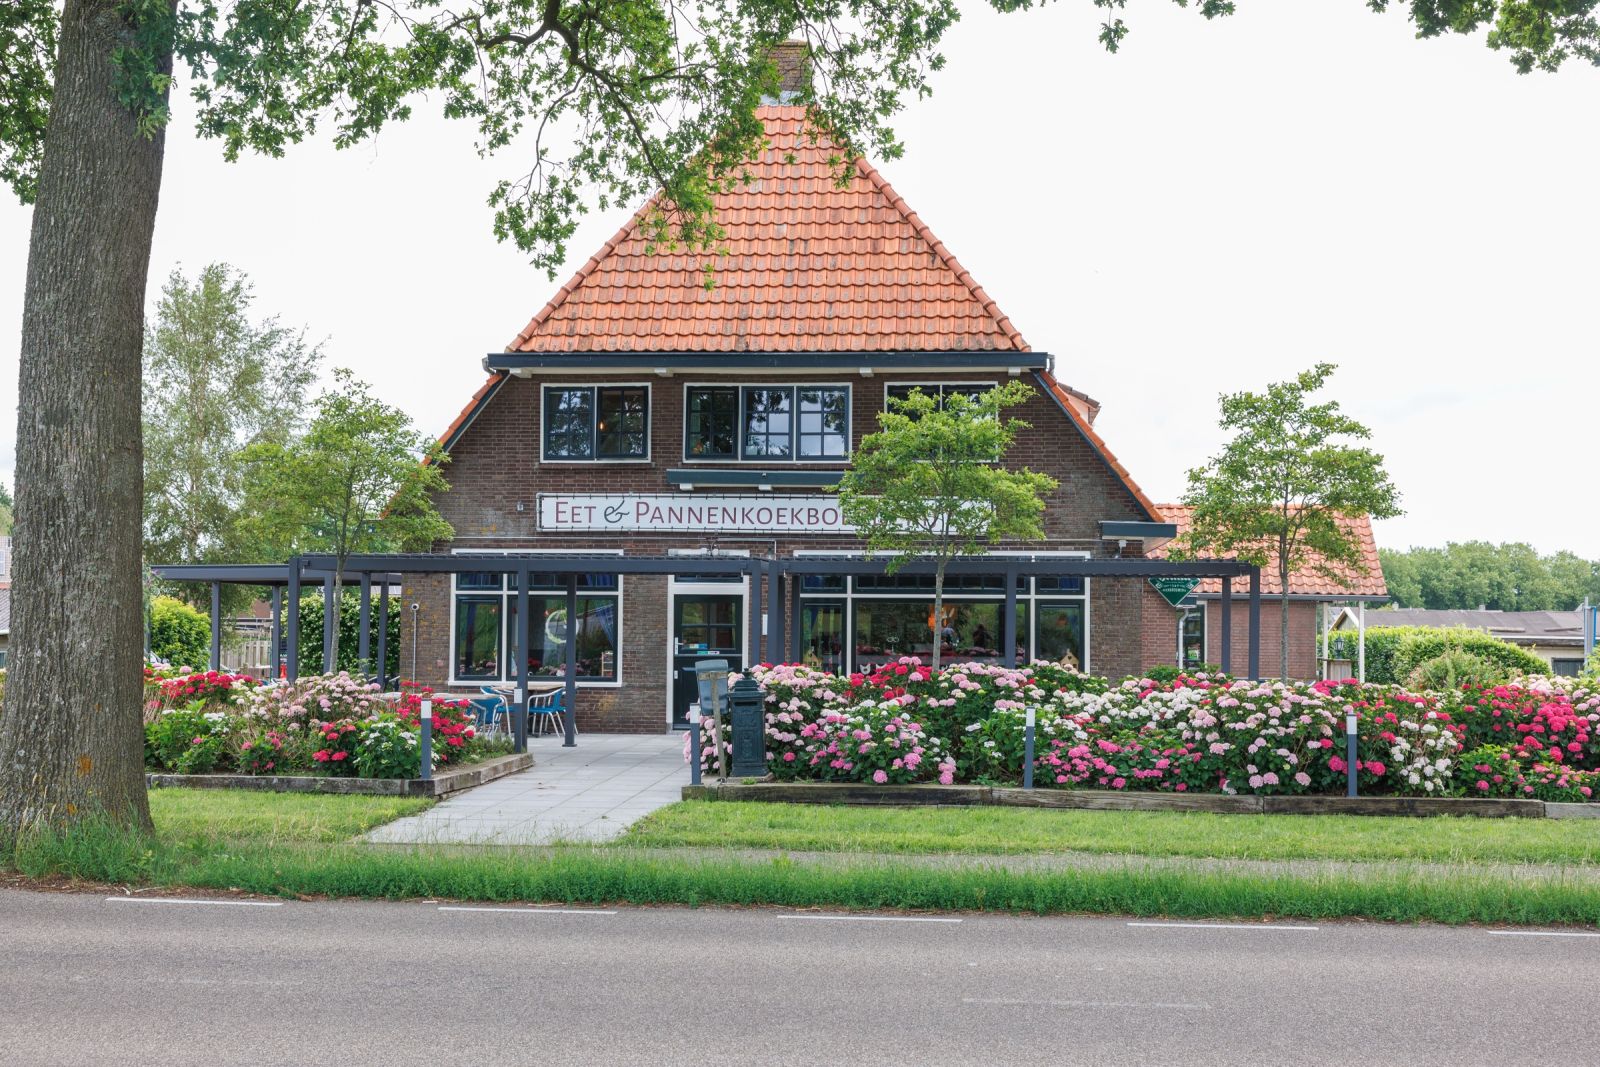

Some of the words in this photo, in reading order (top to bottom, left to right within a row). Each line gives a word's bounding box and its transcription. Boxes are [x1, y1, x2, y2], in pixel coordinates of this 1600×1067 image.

[555, 501, 597, 524] EET
[603, 499, 631, 524] &
[635, 501, 938, 527] PANNENKOEKBO
